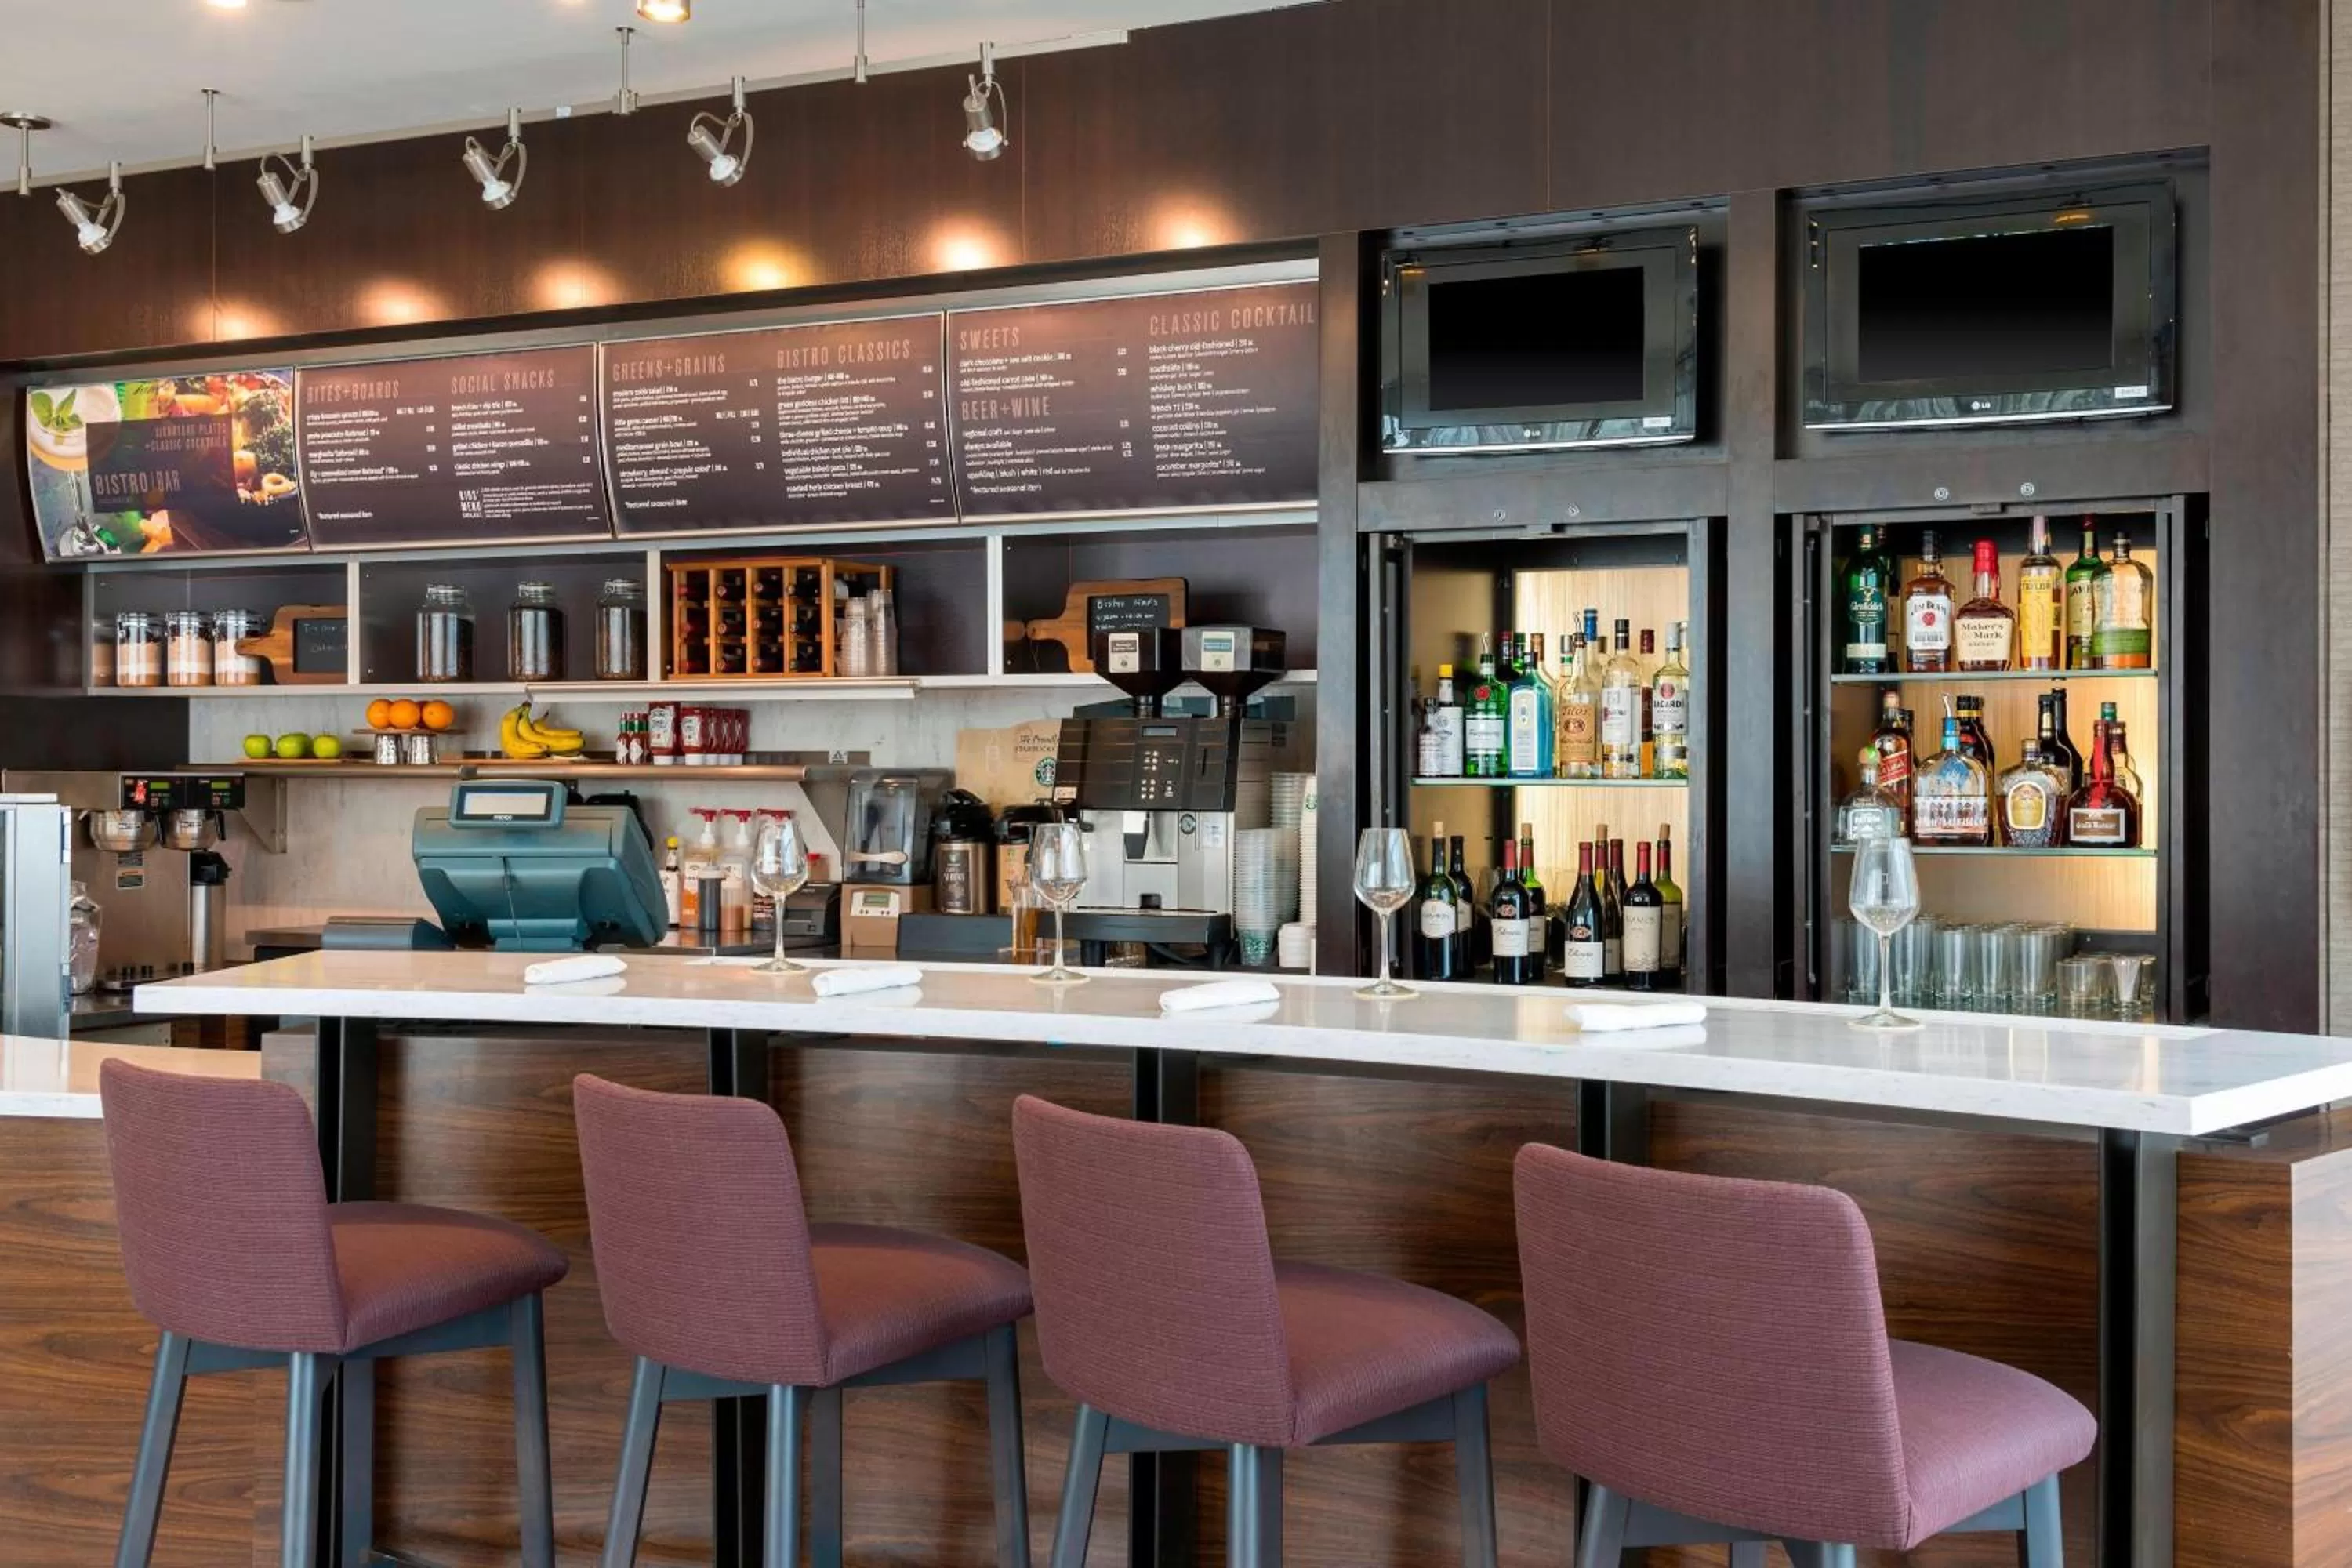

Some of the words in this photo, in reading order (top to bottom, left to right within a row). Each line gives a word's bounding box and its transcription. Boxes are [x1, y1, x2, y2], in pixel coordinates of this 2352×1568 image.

[1150, 310, 1220, 336] CLASSIC
[1232, 303, 1314, 330] COCKTAIL
[960, 326, 1019, 351] SWEETS
[777, 347, 829, 369] BISTRO
[838, 339, 910, 365] CLASSICS
[451, 373, 496, 394] SOCIAL
[504, 369, 554, 390] SNACKS
[95, 471, 148, 495] BISTRO
[157, 470, 180, 492] BAR
